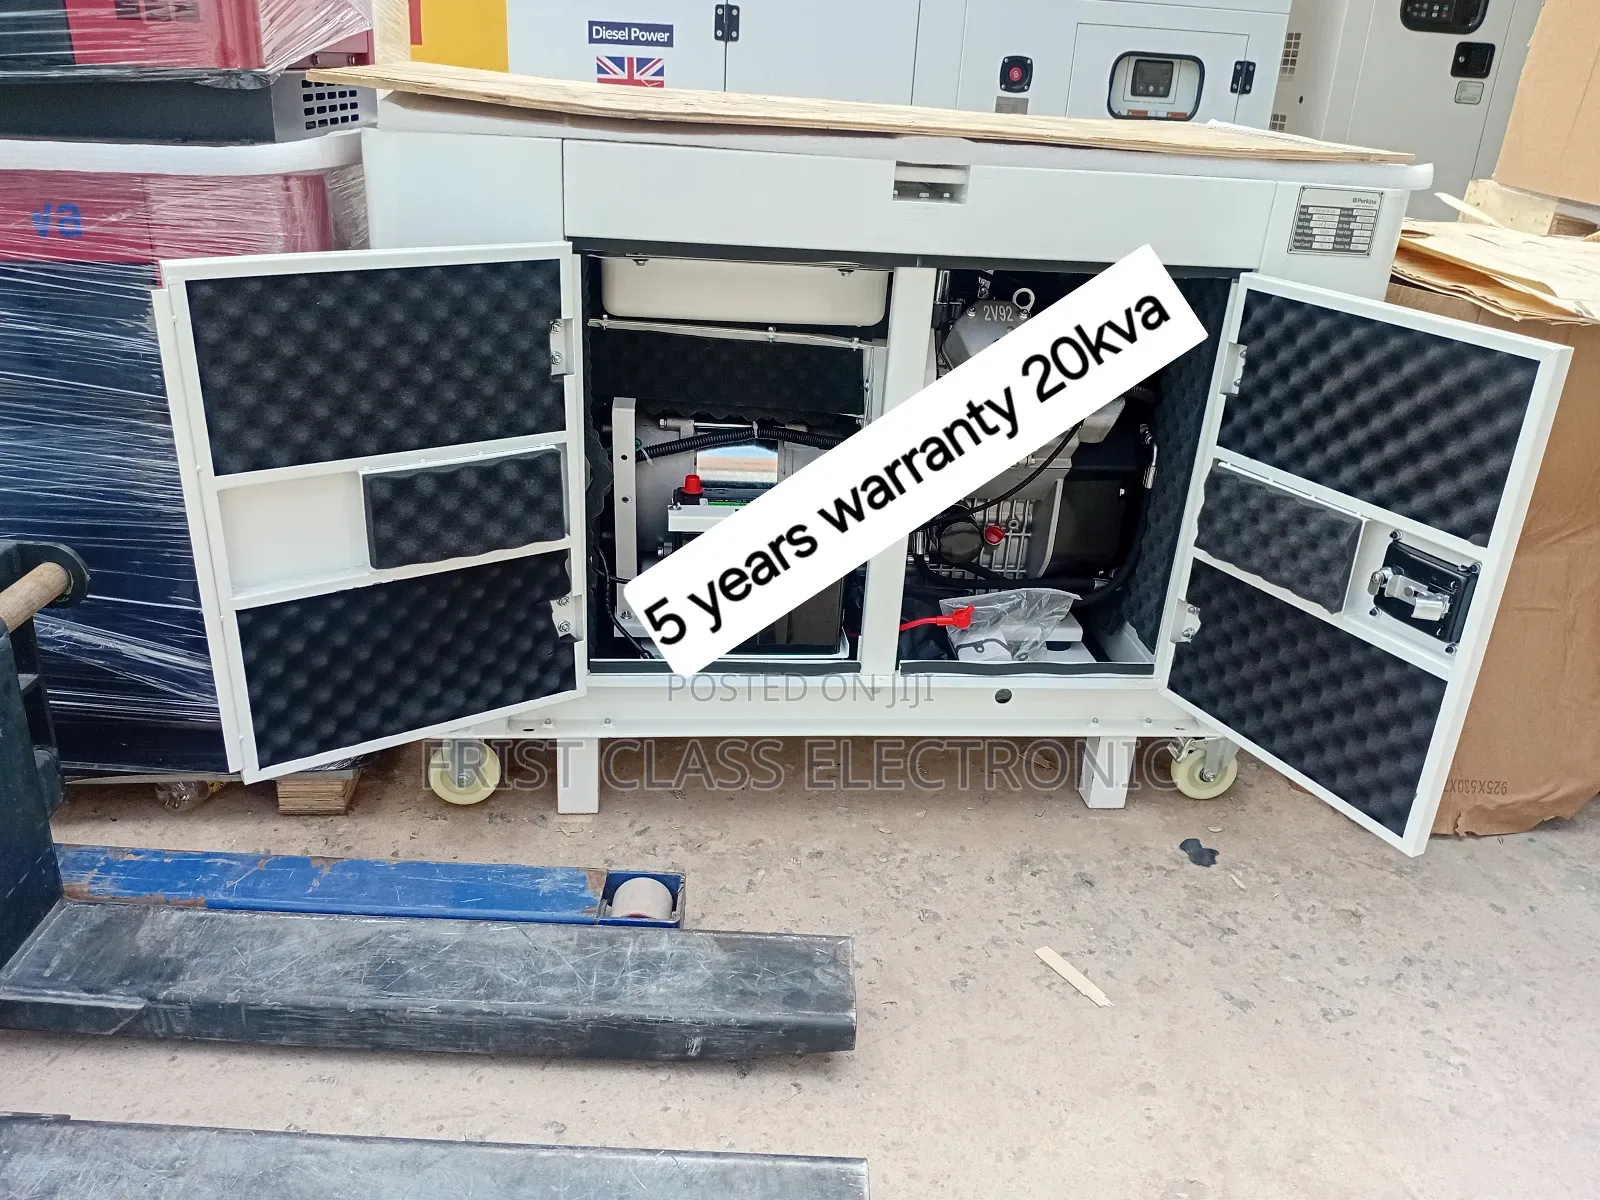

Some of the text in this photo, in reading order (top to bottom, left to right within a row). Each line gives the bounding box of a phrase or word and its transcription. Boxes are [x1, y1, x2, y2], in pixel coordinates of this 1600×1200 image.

[592, 25, 669, 42] Diesel Power
[983, 304, 1014, 322] 2V92
